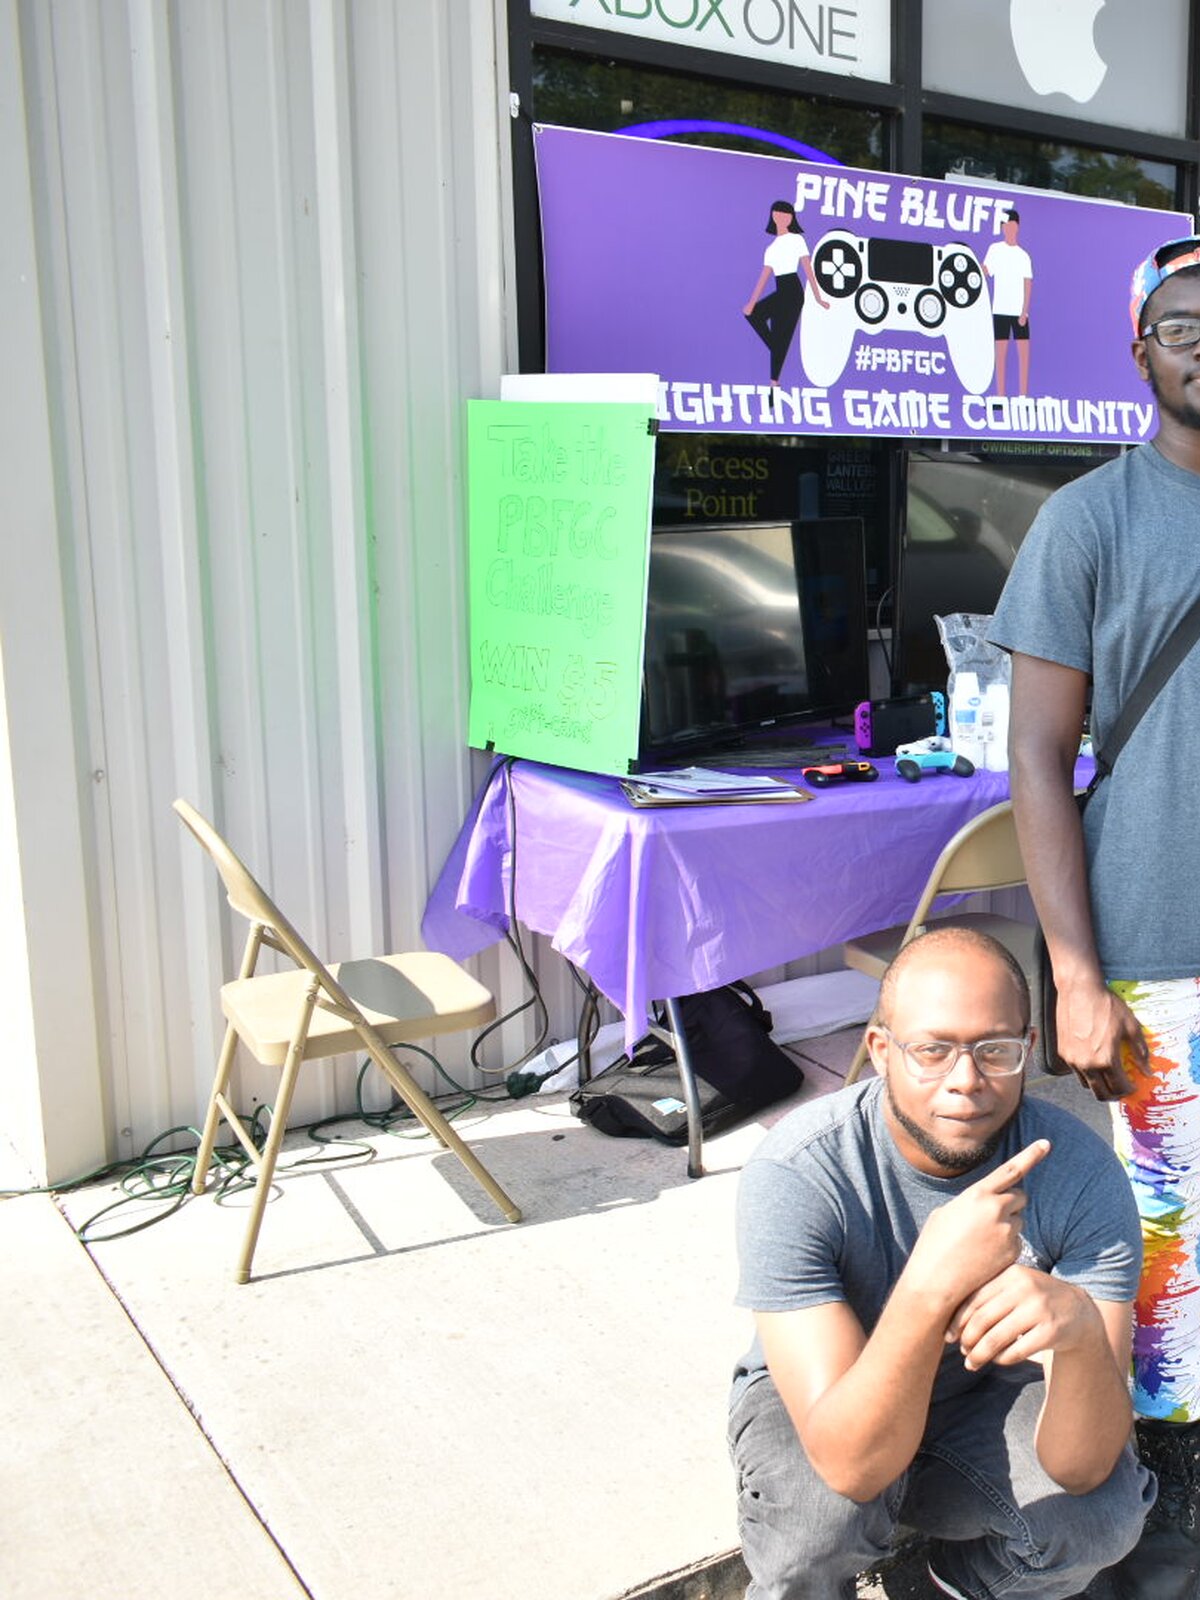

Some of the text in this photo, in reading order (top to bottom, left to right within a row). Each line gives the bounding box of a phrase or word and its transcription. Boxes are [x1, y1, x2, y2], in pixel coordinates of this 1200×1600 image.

[569, 0, 859, 62] OX ONE
[793, 172, 1015, 235] PINE BLUFF
[855, 345, 946, 375] #PBFGC
[656, 381, 1154, 437] IGHTING GAME COMMUNITY
[487, 421, 568, 483] Take
[673, 449, 769, 480] Access
[982, 443, 1092, 457] OWNERSHIP OPTIONS
[497, 493, 618, 560] PBFGC
[683, 488, 757, 517] Point
